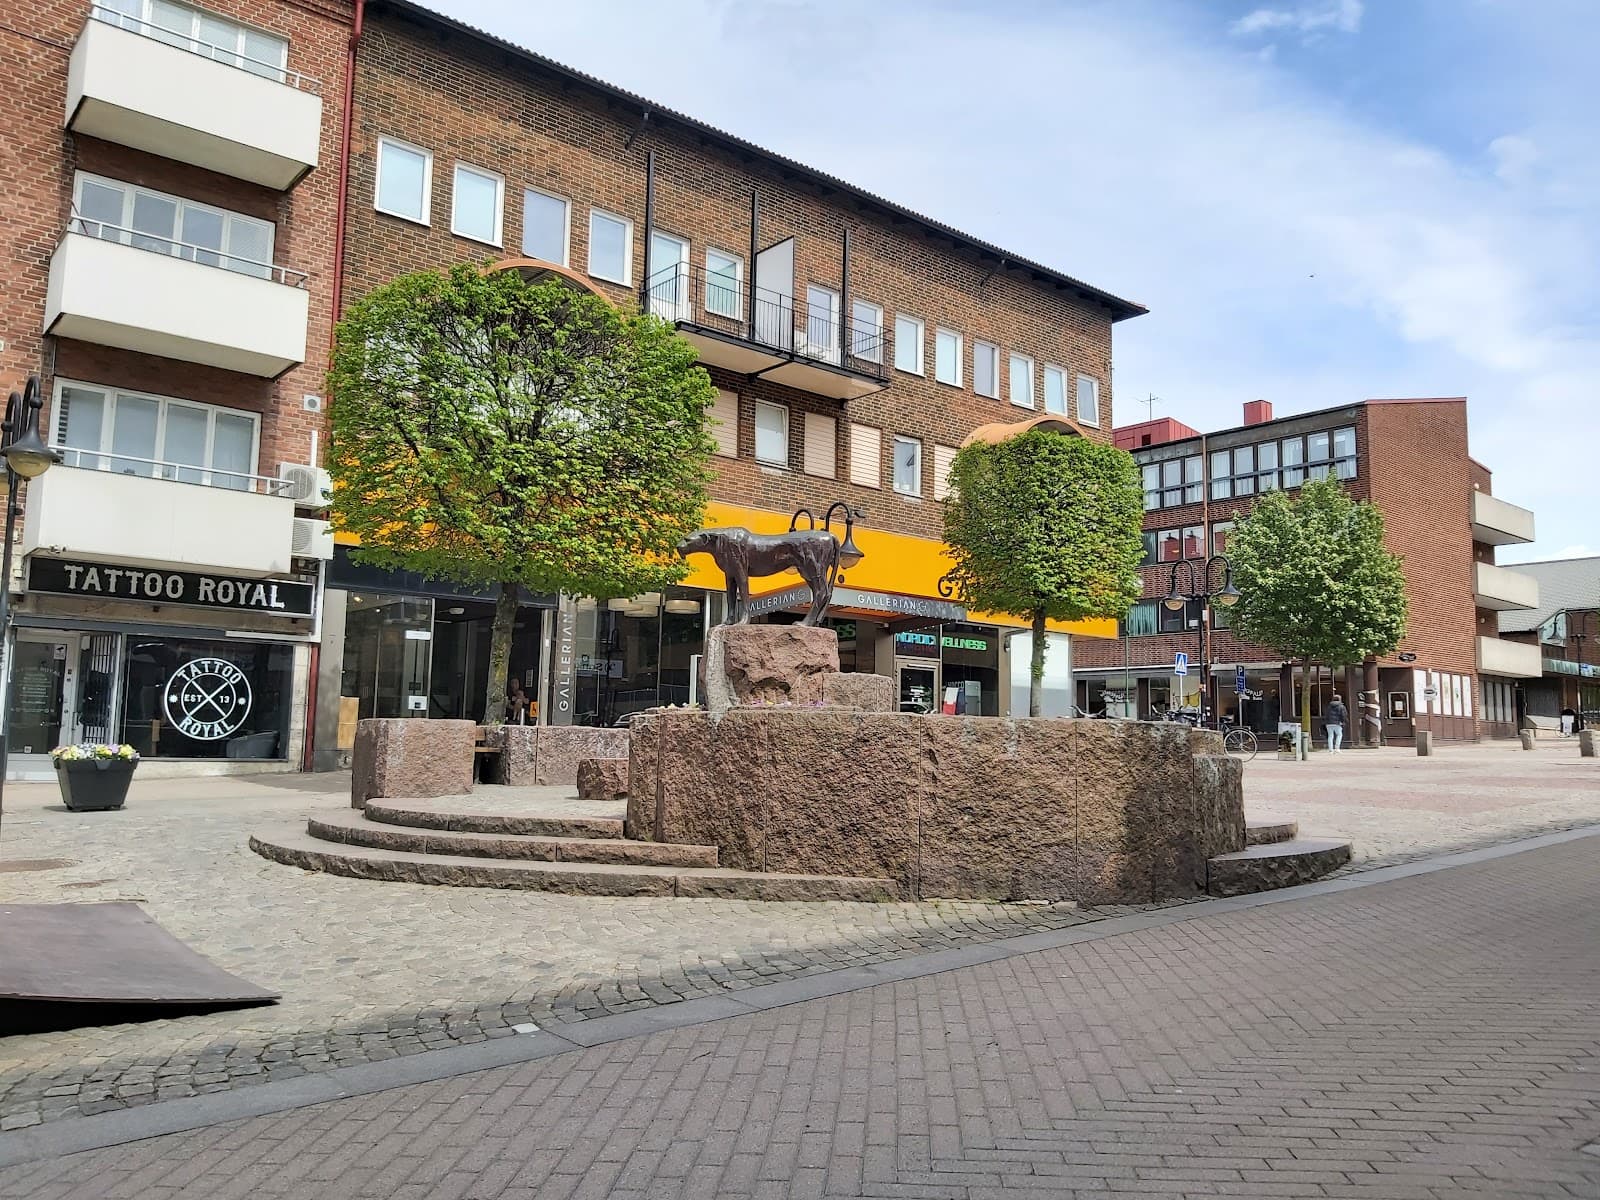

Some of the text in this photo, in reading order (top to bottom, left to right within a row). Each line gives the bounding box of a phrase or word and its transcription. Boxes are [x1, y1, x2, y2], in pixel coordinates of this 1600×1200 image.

[64, 565, 285, 609] TATTOO ROYAL
[750, 592, 795, 611] ALLERIAN
[857, 594, 916, 610] GALLERIAN
[177, 661, 241, 684] TATTOO
[559, 613, 573, 712] GALLERIAN
[184, 694, 230, 703] EST 13
[179, 716, 235, 738] ROYAL
